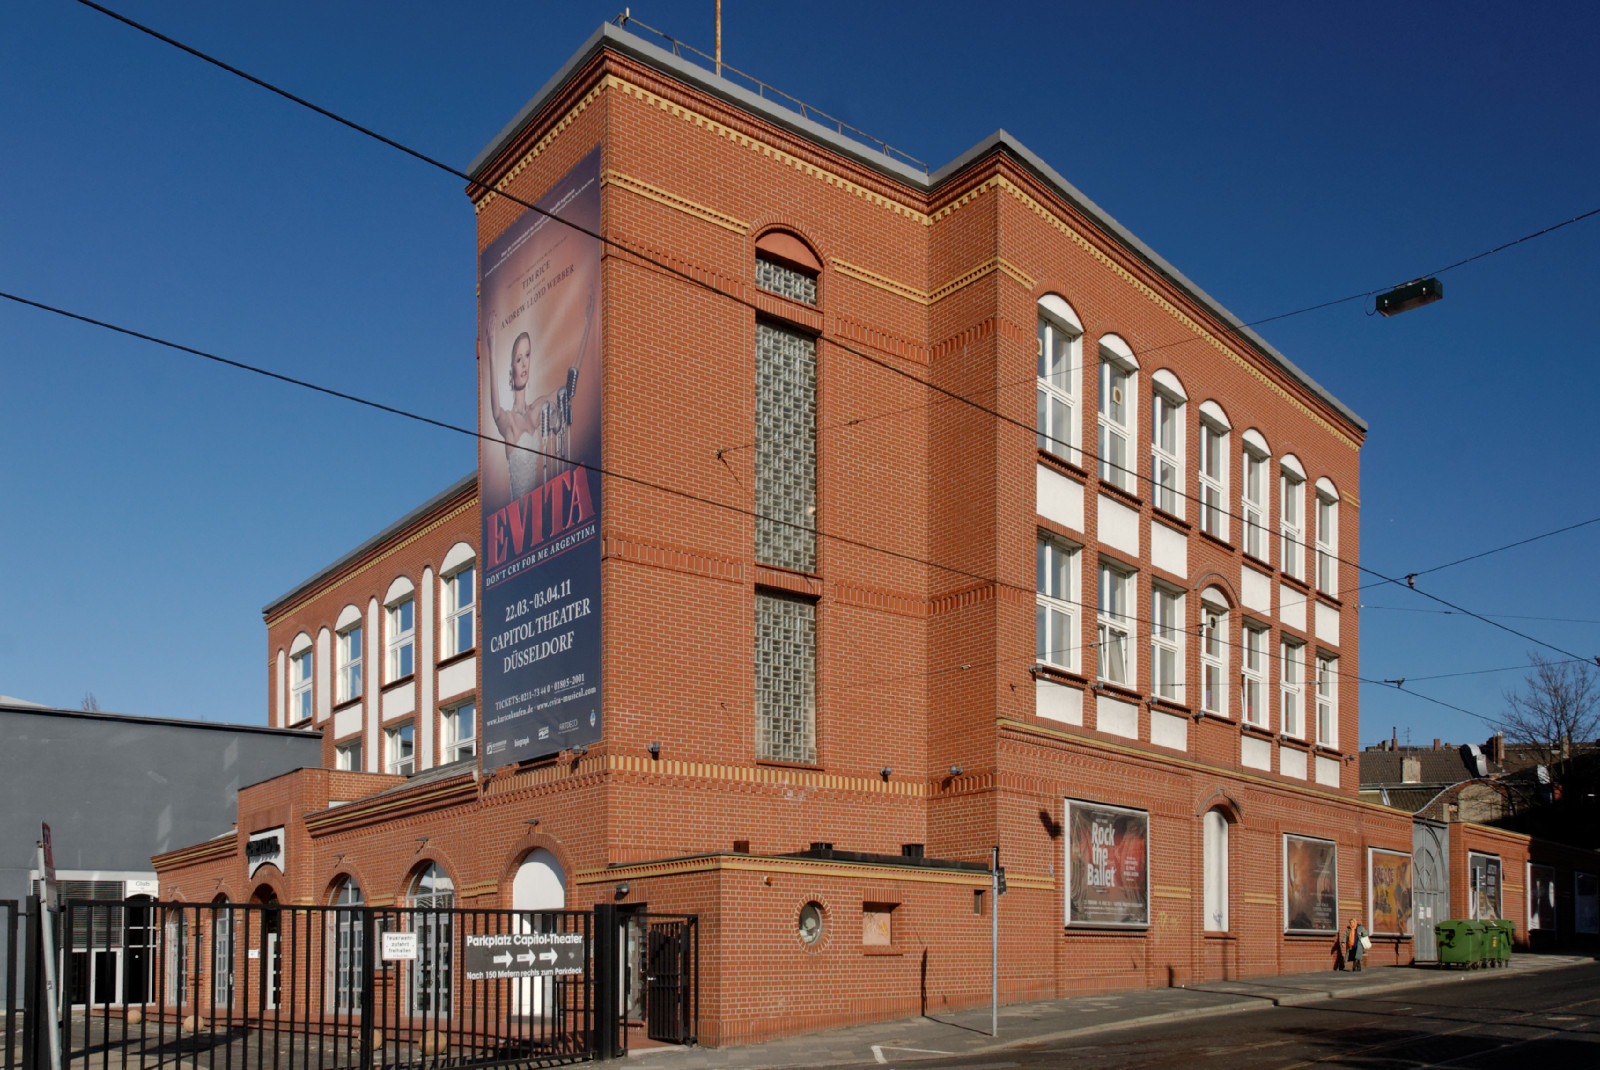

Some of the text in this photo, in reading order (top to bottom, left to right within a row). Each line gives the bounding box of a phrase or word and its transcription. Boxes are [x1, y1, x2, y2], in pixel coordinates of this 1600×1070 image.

[521, 274, 534, 290] TIM
[535, 260, 551, 278] RICE
[501, 303, 526, 329] ANDREW
[527, 287, 546, 309] LLOYD
[547, 264, 575, 291] WEBBER
[486, 461, 596, 571] EVITA
[486, 524, 596, 587] DON'T CRY FOR ME ARGENTINA
[490, 597, 592, 653] CAPITOL THEATER
[503, 630, 575, 674] DÜSSELDORF
[495, 694, 521, 711] TICKETS:
[1091, 821, 1115, 847] Rock
[1092, 844, 1109, 866] the
[1087, 863, 1117, 888] Ballet
[466, 933, 583, 948] Parkplatz Capitol-Theater
[466, 967, 583, 980] Nach 150 Metern rechts zum Parkdeck
